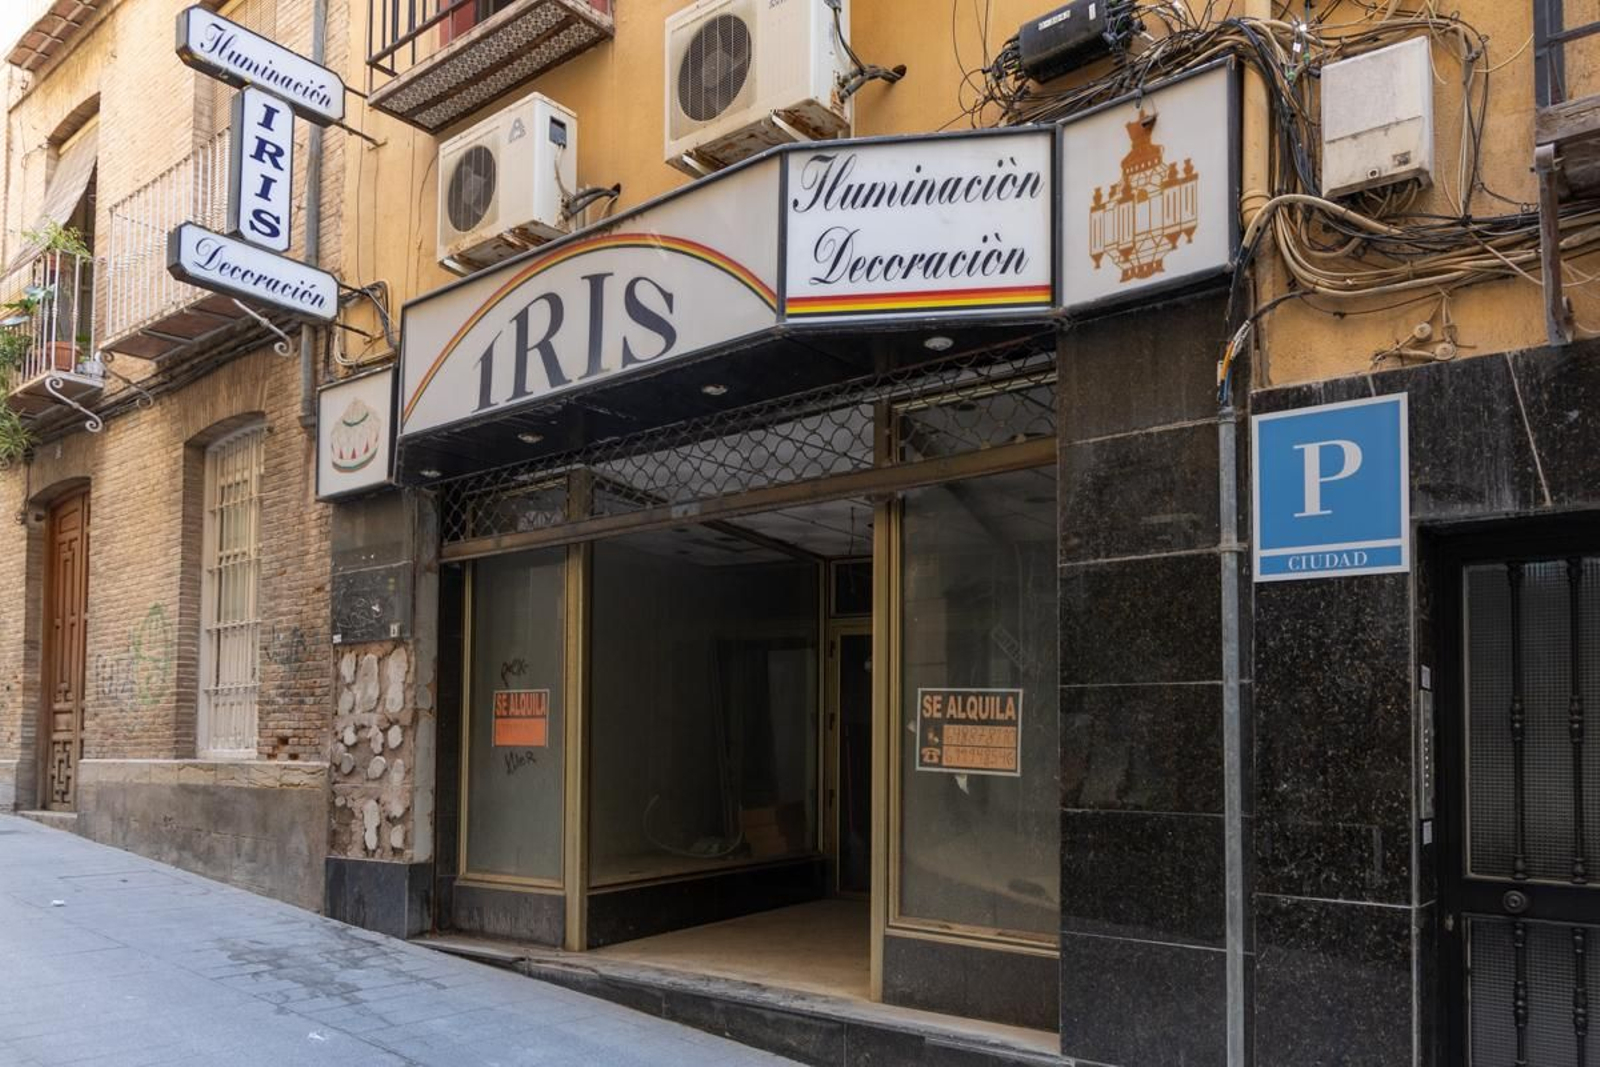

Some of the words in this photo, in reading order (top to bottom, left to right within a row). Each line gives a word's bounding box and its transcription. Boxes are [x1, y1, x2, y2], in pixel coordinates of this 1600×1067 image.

[249, 103, 285, 239] IRIS
[192, 236, 328, 310] Decoración
[471, 272, 678, 414] IRIS
[1292, 439, 1363, 517] P
[1288, 551, 1368, 571] CIUDAD
[496, 692, 508, 716] SE
[508, 692, 546, 716] ALQUILA
[922, 695, 942, 718] SE
[946, 695, 1016, 721] ALQUILA
